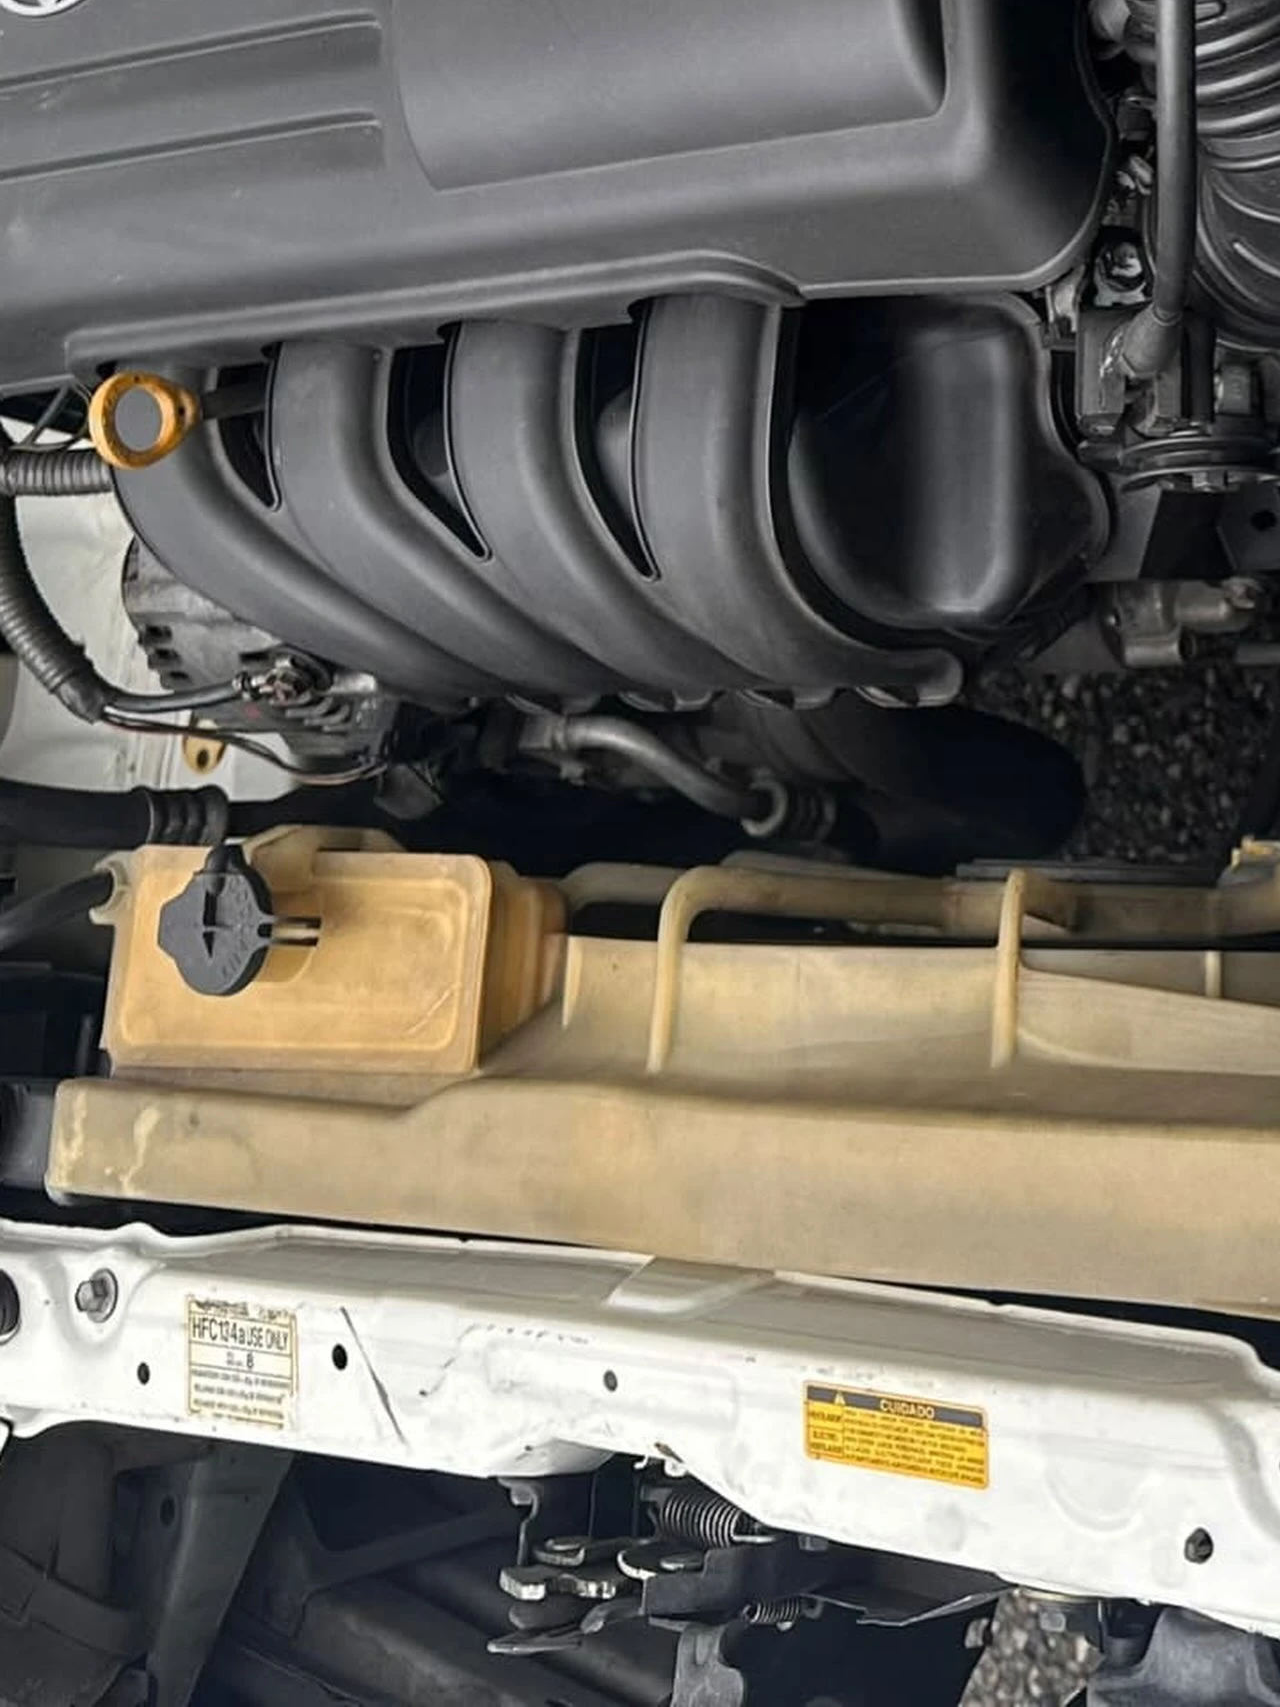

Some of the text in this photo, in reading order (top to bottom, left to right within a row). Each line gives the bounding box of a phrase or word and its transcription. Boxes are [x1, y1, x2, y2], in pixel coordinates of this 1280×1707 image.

[246, 1325, 264, 1349] USE
[264, 1327, 289, 1351] ONLY
[878, 1398, 936, 1420] CUIDADO
